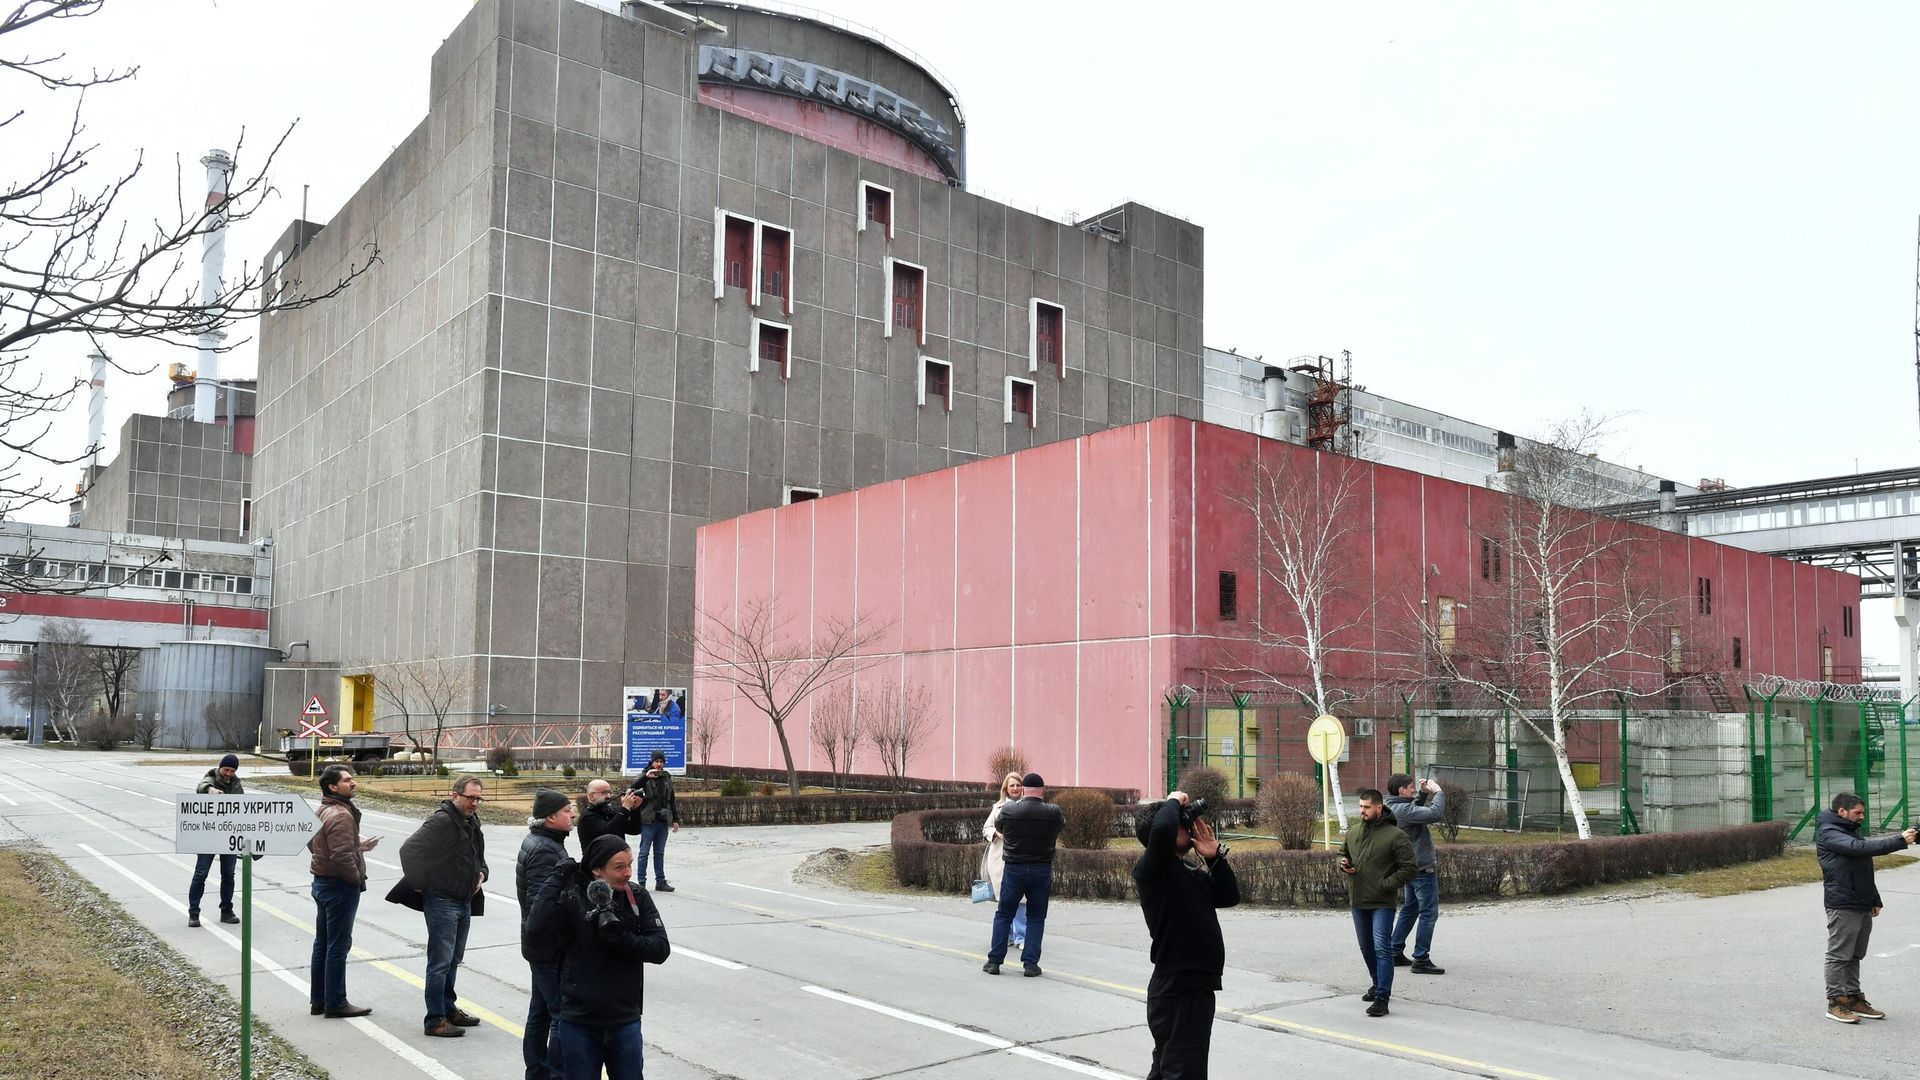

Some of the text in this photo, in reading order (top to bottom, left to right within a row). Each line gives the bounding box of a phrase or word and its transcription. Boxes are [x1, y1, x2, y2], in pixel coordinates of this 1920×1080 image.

[181, 802, 293, 816] МІСЦЕ ДЛЯ УКРИТТЯ
[180, 821, 201, 832] (блок
[203, 822, 216, 831] №4
[218, 821, 256, 833] оббудова
[275, 822, 296, 832] сх/кл
[298, 822, 313, 832] №2
[229, 835, 244, 851] 90
